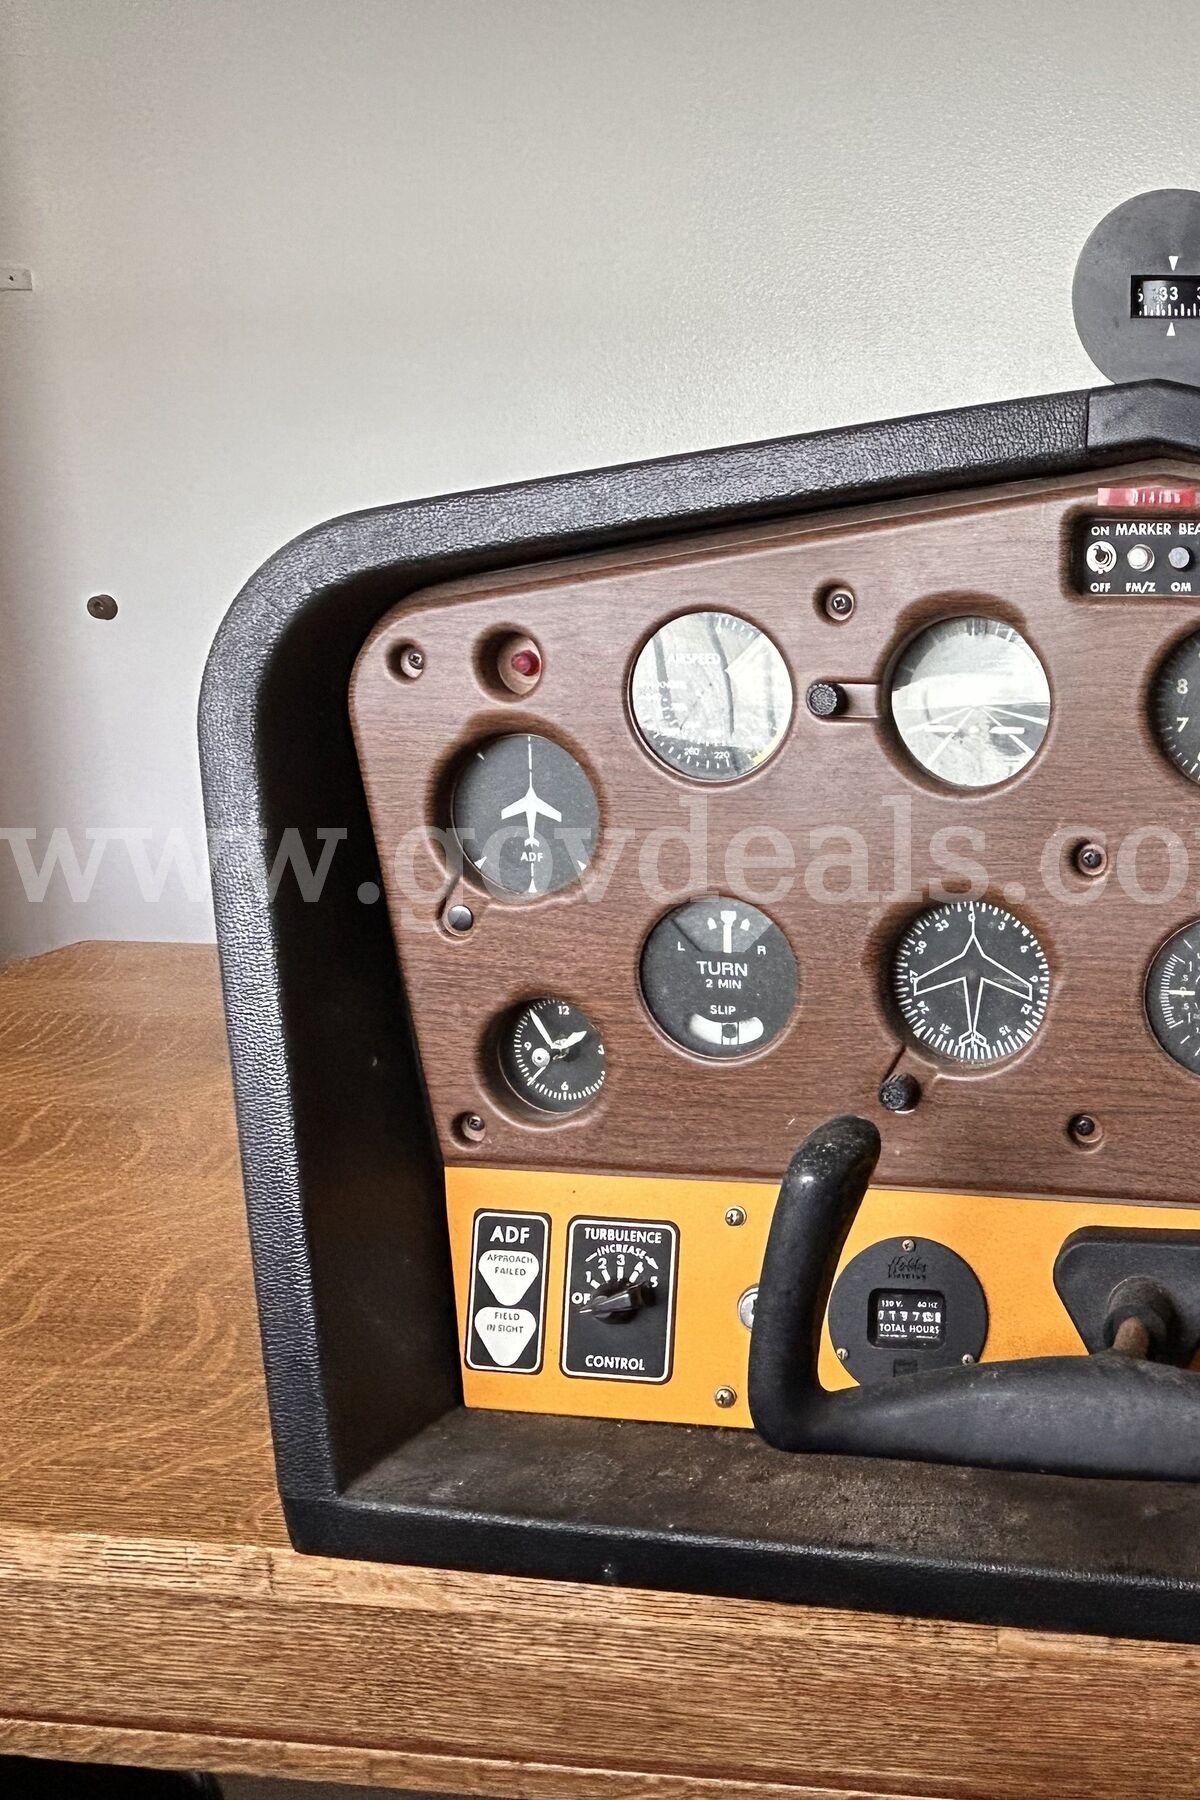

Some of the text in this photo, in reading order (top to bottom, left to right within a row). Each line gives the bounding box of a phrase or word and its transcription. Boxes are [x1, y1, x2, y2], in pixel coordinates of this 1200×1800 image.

[1091, 526, 1110, 536] ON
[1115, 523, 1172, 536] MARKER
[1090, 582, 1111, 593] OFF
[1125, 581, 1156, 593] FM/Z
[1170, 582, 1191, 592] OM
[1176, 678, 1188, 694] 8
[1176, 717, 1189, 733] 7
[520, 852, 544, 863] ADF
[935, 919, 950, 932] 33
[998, 921, 1006, 931] 3
[677, 941, 685, 951] L
[757, 945, 767, 955] R
[915, 940, 927, 955] 30
[696, 960, 748, 977] TURN
[705, 978, 742, 989] 2 MIN
[558, 1005, 570, 1015] 12
[710, 1005, 736, 1015] SLIP
[524, 1041, 532, 1051] 9
[561, 1081, 569, 1091] 6
[490, 1225, 530, 1244] ADF
[584, 1227, 662, 1244] TURBULENCE
[597, 1244, 647, 1258] INCREASE
[487, 1253, 533, 1264] APPROACH
[598, 1257, 607, 1269] 2
[616, 1255, 625, 1266] 3
[494, 1266, 526, 1276] FAILED
[585, 1271, 591, 1283] 1
[649, 1276, 658, 1288] 5
[494, 1312, 520, 1321] FIELD
[486, 1324, 524, 1334] IN SIGHT
[879, 1323, 940, 1334] TOTAL HOURS
[585, 1354, 645, 1371] CONTROL
